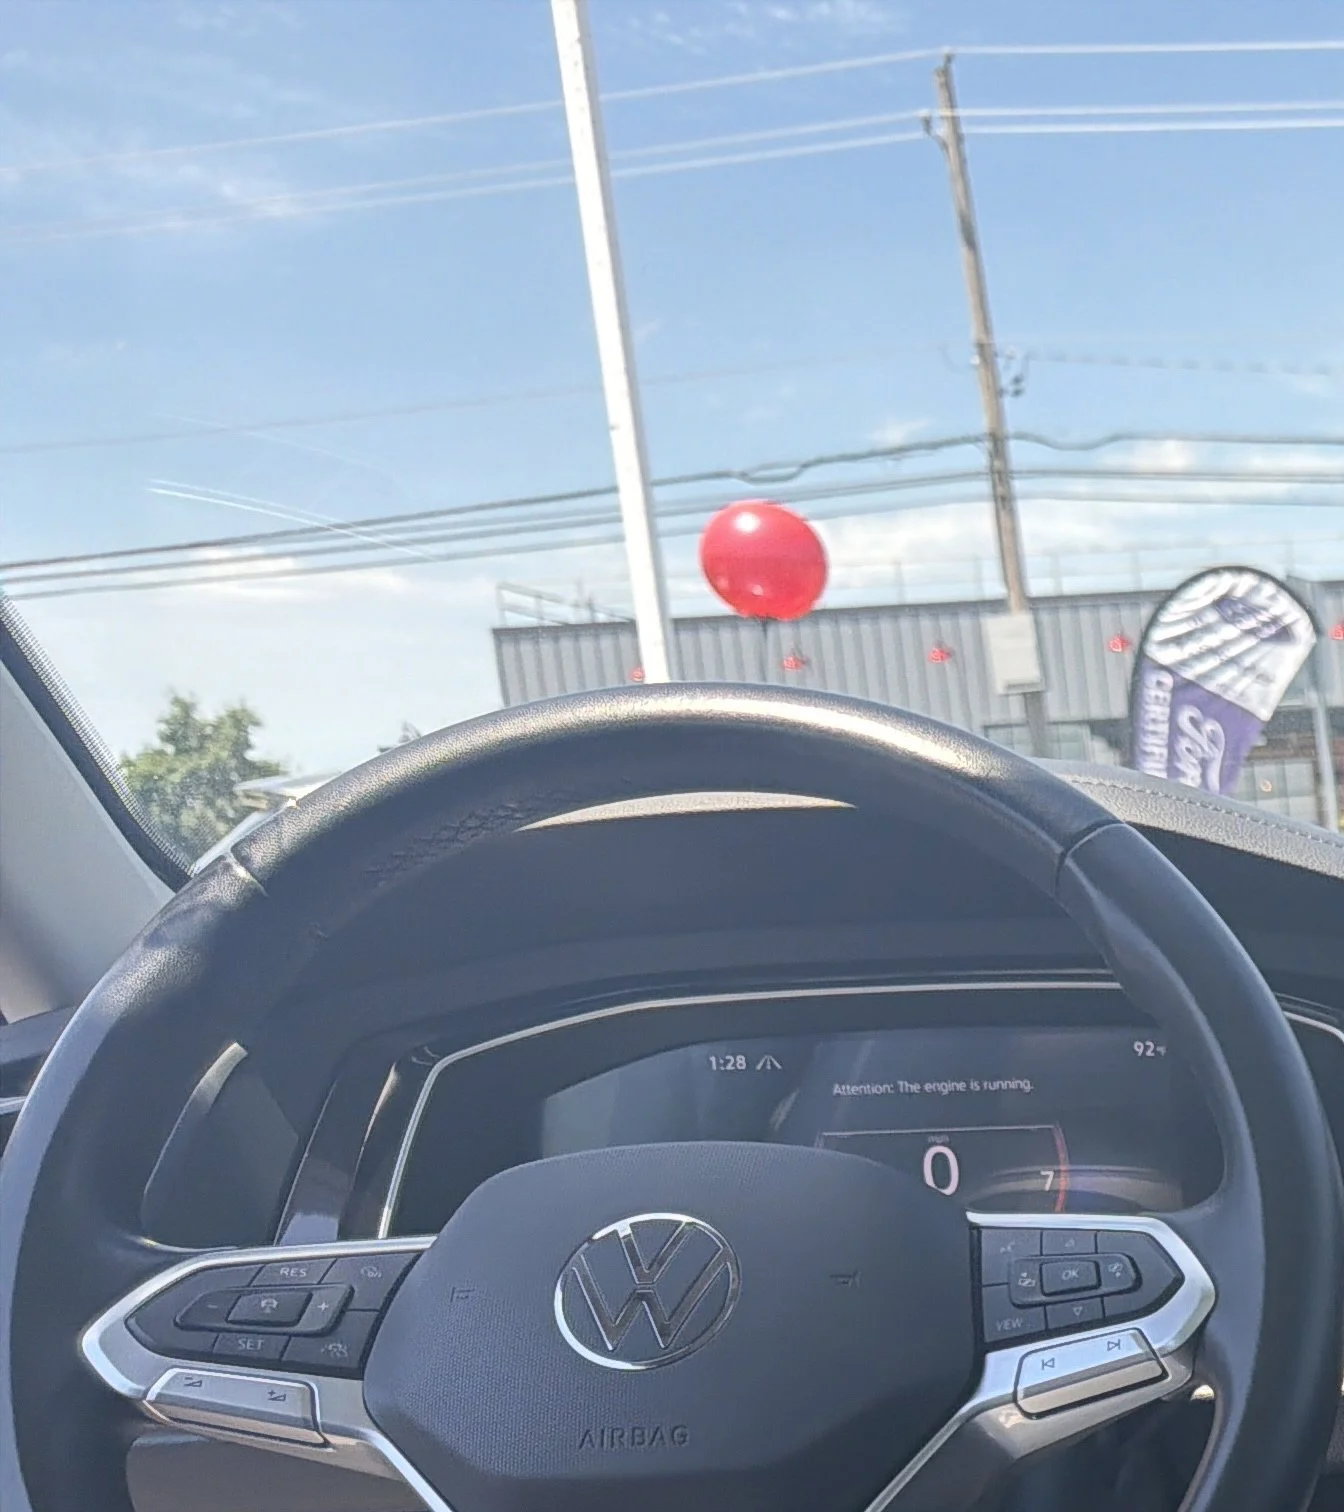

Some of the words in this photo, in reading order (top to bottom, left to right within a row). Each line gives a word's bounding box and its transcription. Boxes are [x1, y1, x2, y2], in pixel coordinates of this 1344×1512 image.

[709, 1055, 747, 1071] 1:28
[833, 1083, 894, 1096] Attention:
[897, 1080, 921, 1094] The
[924, 1080, 967, 1095] engine
[970, 1078, 981, 1091] is
[983, 1078, 1034, 1093] running.
[923, 1145, 959, 1196] 0
[1040, 1170, 1055, 1192] 7
[280, 1267, 307, 1278] RES
[1062, 1269, 1080, 1281] OK
[996, 1317, 1023, 1331] VIEW
[238, 1338, 264, 1350] SET
[579, 1425, 688, 1450] AIRBAG
